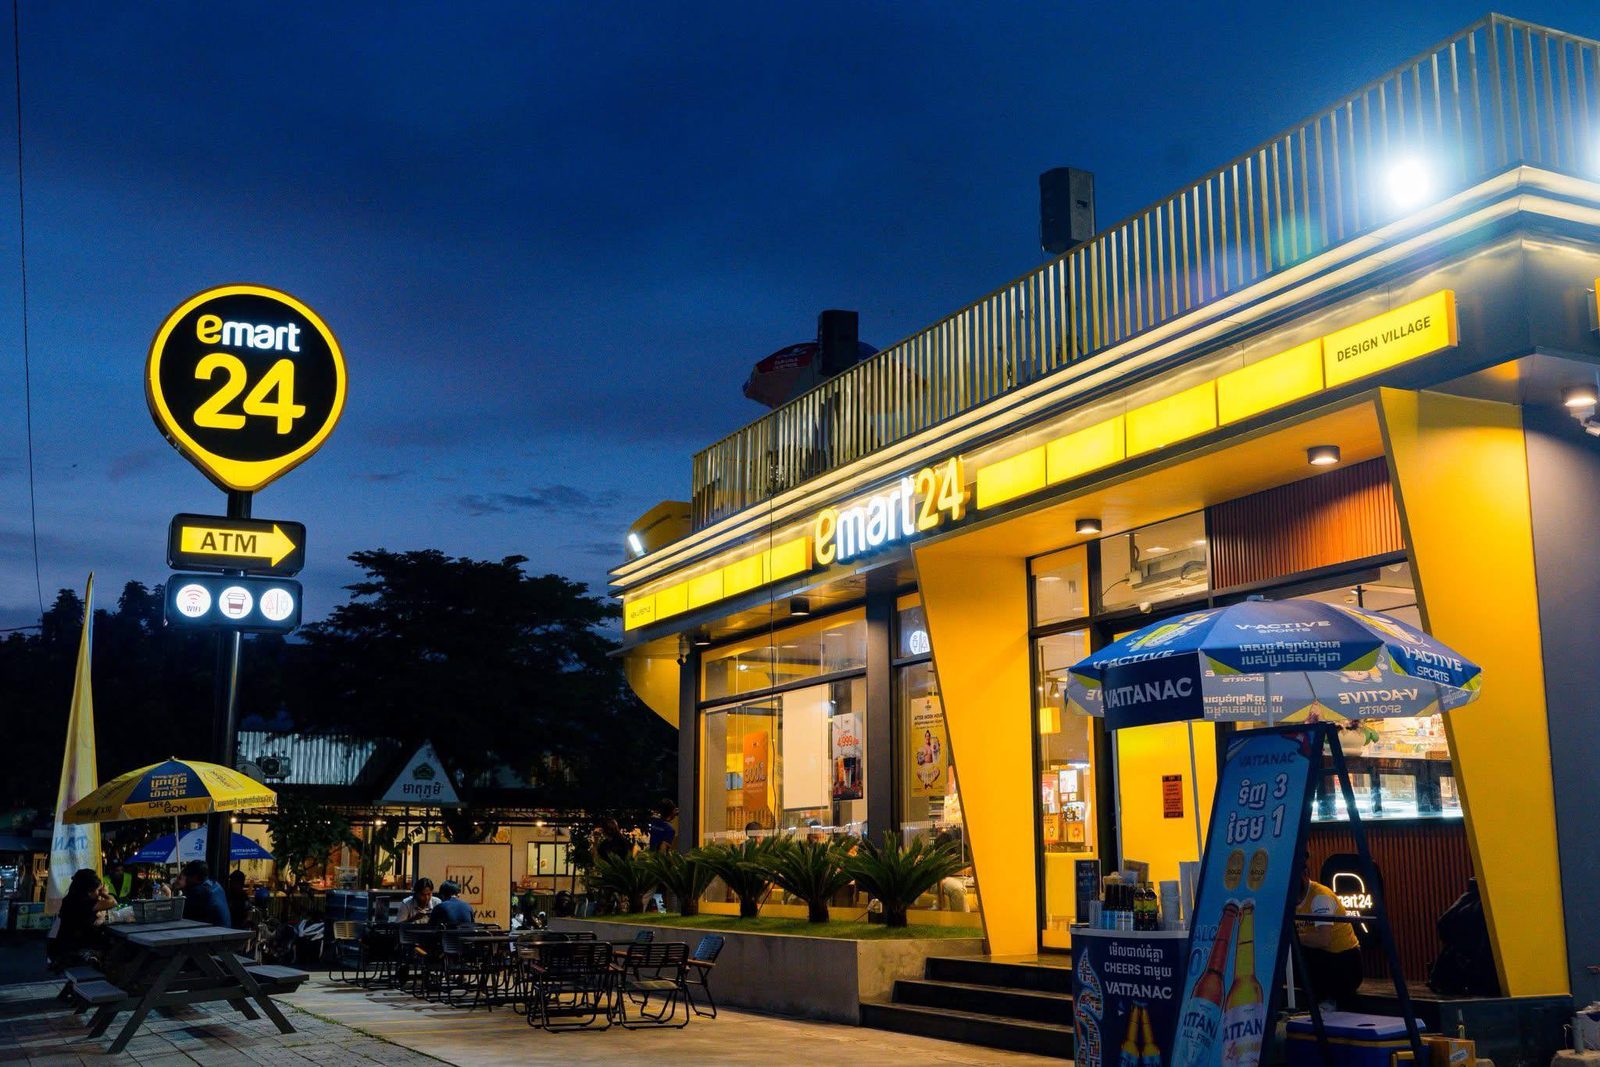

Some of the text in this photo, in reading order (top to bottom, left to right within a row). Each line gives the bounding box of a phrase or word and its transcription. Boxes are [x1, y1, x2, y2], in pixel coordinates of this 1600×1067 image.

[196, 314, 300, 352] emart
[1336, 315, 1432, 362] DESIGN VILLAGE
[193, 352, 306, 435] 24
[200, 531, 257, 554] ATM
[1235, 620, 1332, 630] V-ACTIVE
[1400, 644, 1463, 672] V-ACTIVE
[1416, 665, 1450, 683] SPORTS
[1104, 676, 1193, 709] VATTANAC
[1272, 772, 1289, 799] 3
[1271, 803, 1286, 838] 1
[1104, 961, 1141, 976] CHEERS
[1105, 980, 1173, 1000] VATTANAC
